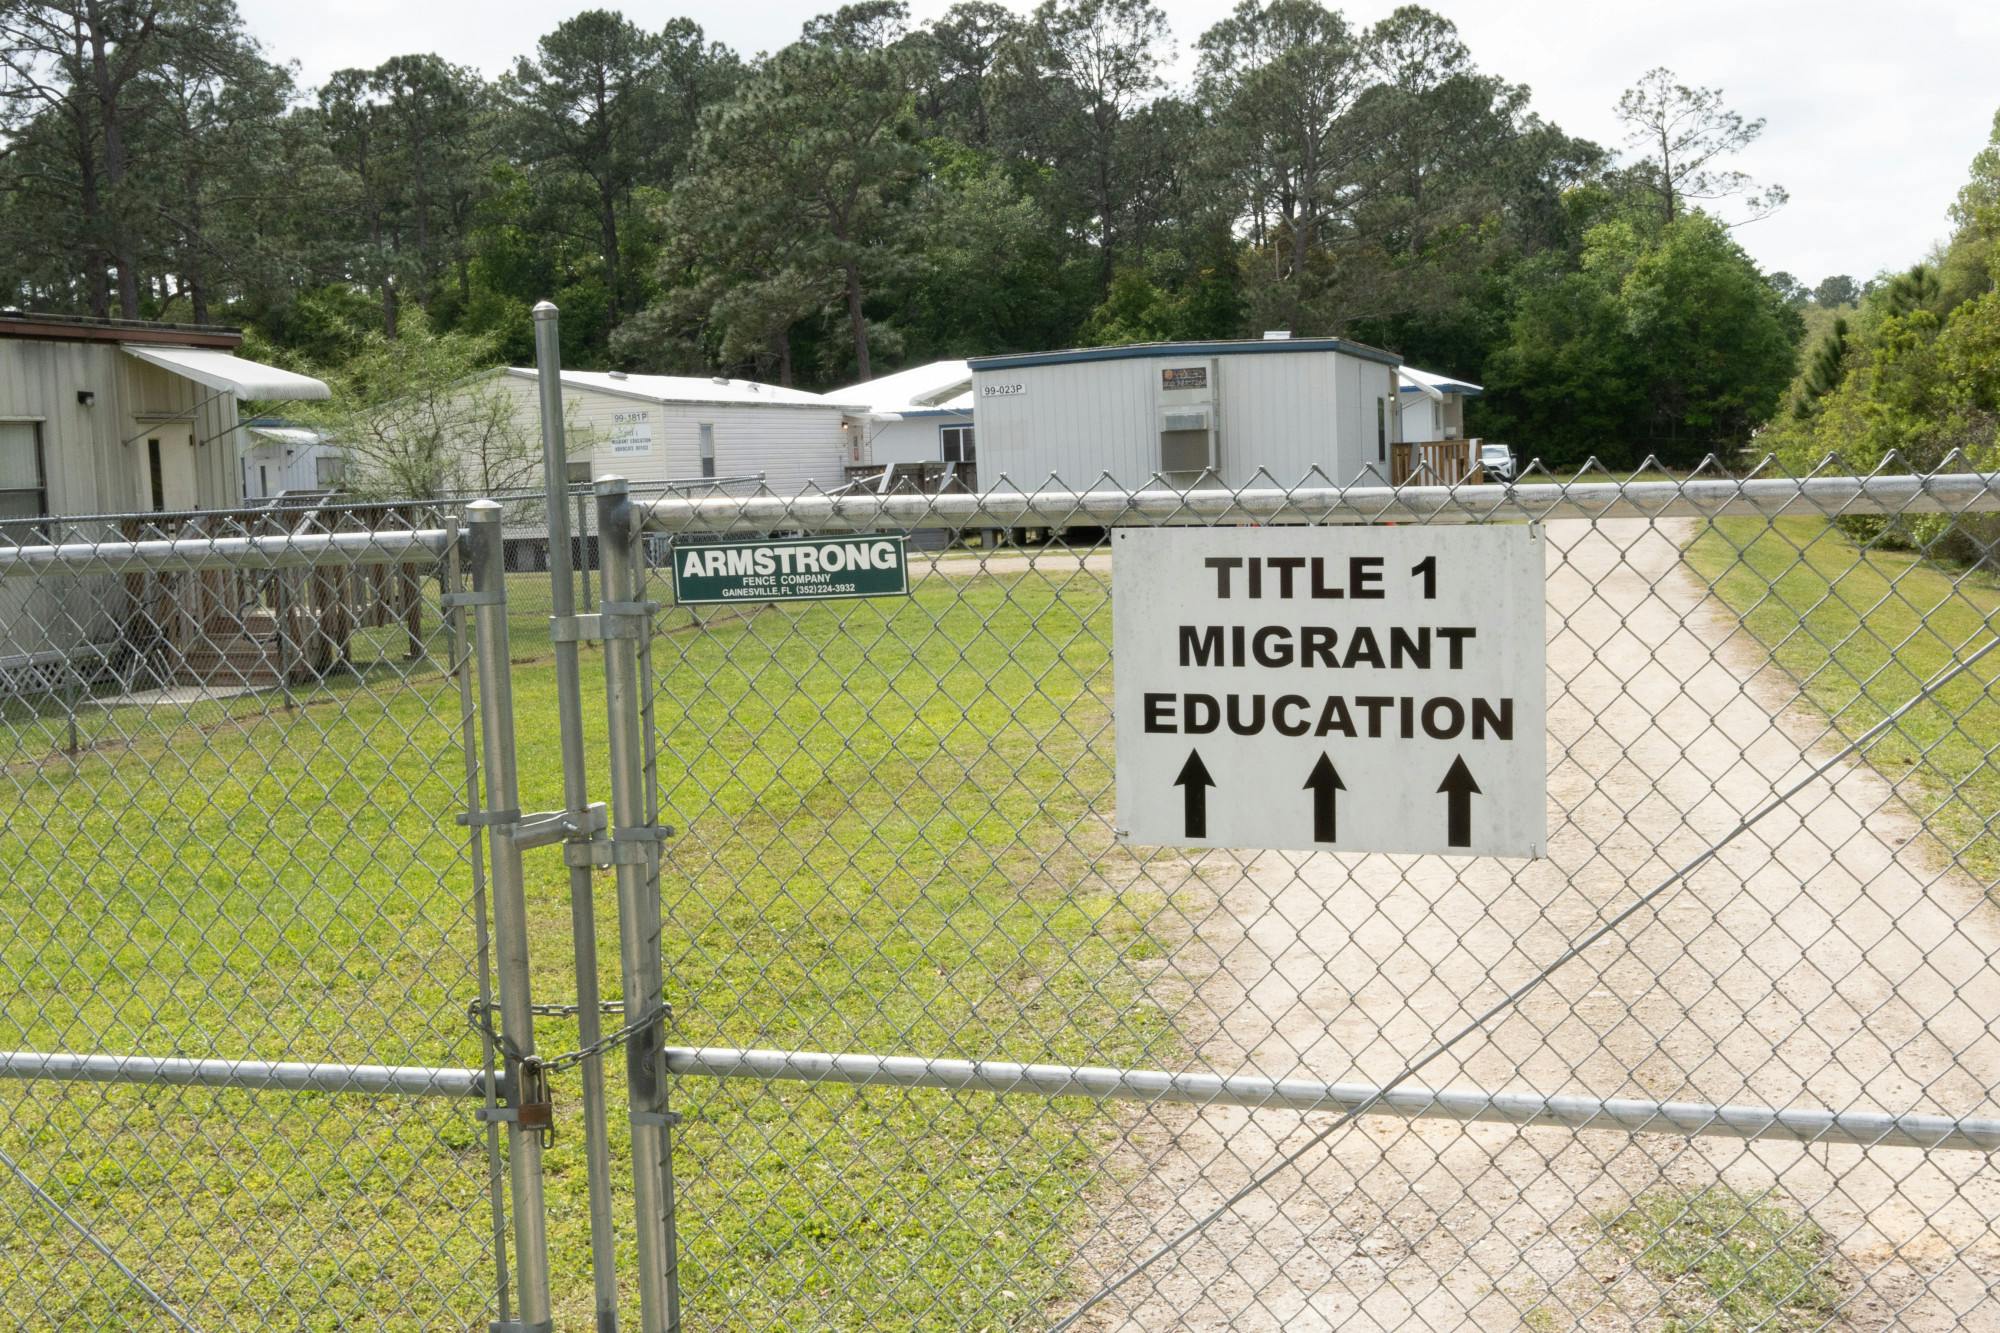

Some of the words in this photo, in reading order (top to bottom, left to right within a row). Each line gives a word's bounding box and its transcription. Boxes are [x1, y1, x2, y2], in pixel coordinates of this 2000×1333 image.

[984, 384, 1022, 395] 99-023P
[683, 541, 897, 577] ARMSTRONG
[722, 587, 780, 597] GAINESVILLE,
[781, 587, 792, 595] FL
[743, 576, 776, 586] FENCE
[780, 574, 831, 585] COMPANY
[1205, 556, 1385, 599] TITLE
[1411, 556, 1436, 599] 1
[1179, 625, 1476, 670] MIGRANT
[1144, 692, 1513, 740] EDUCATION
